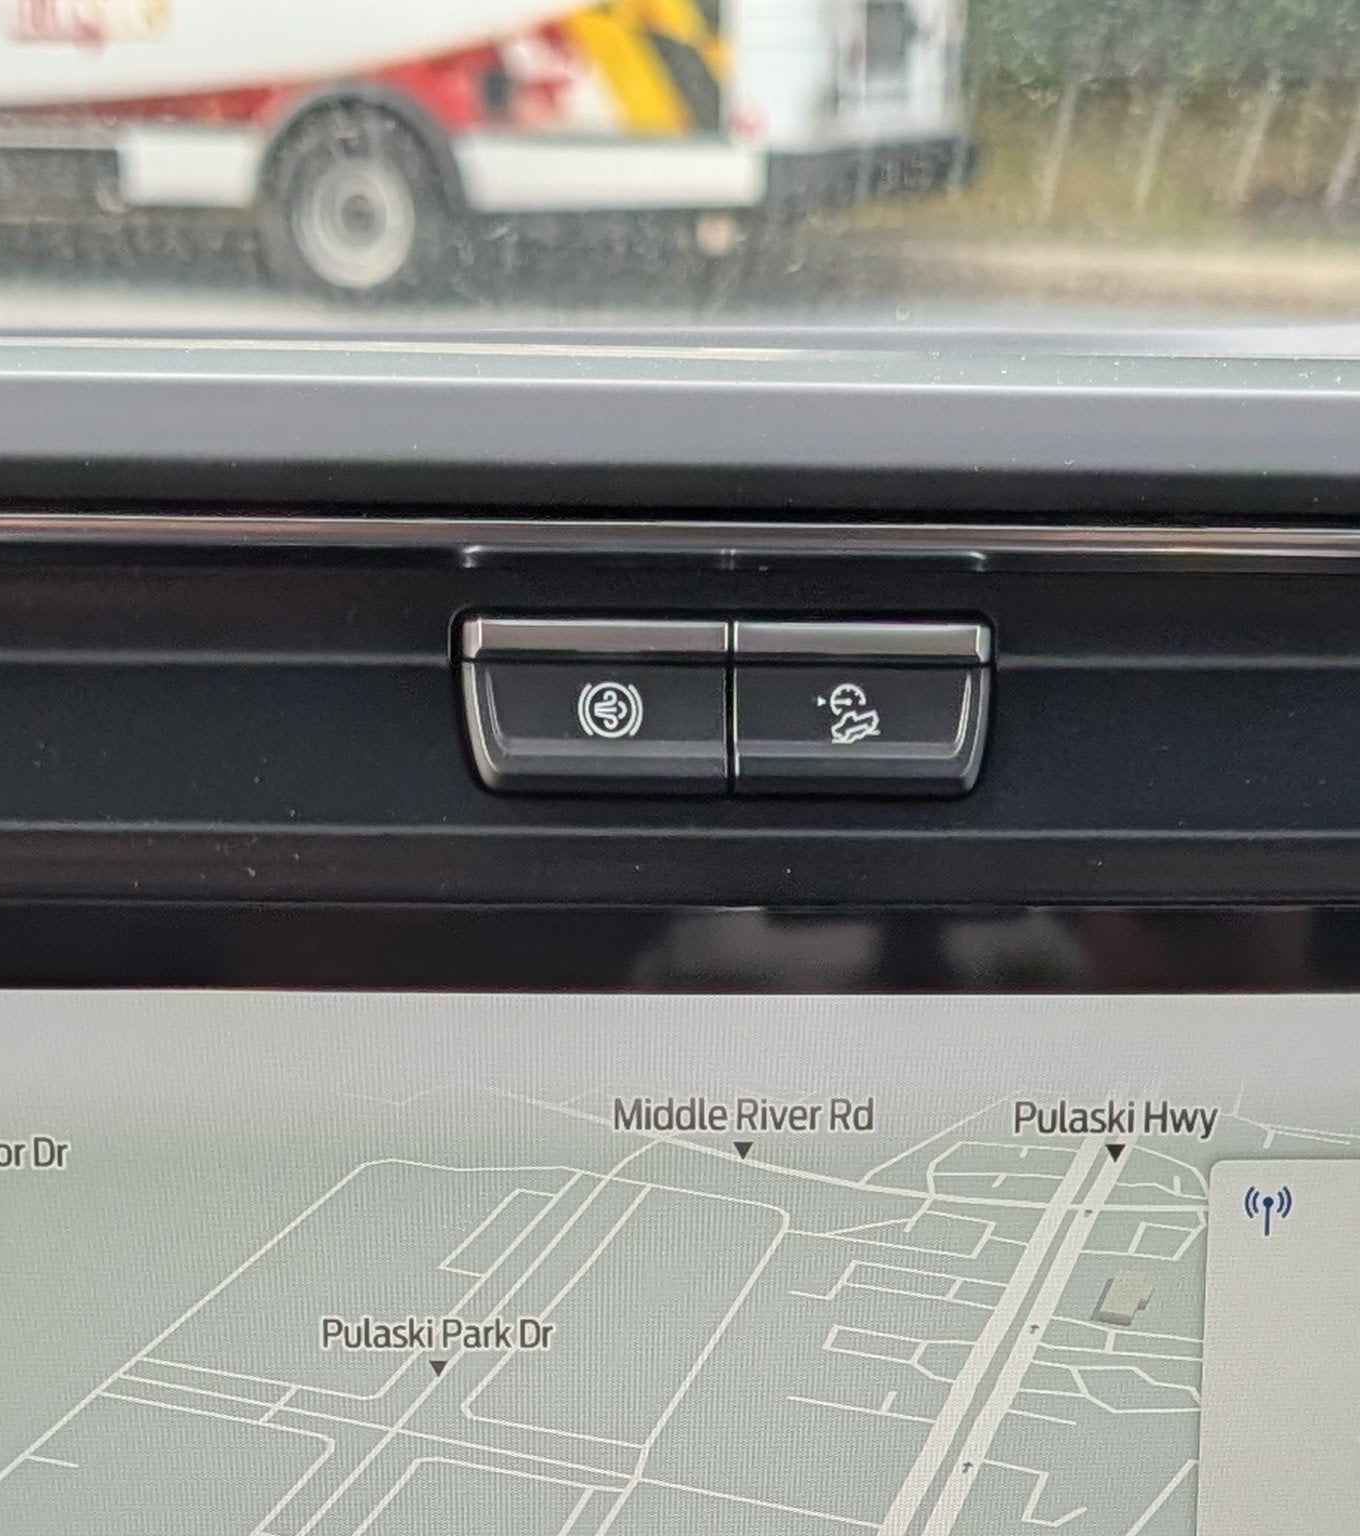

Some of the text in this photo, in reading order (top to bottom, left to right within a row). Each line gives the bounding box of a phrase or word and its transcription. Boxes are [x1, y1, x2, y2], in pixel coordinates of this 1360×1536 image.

[614, 1097, 874, 1131] Middle River Rd
[1015, 1100, 1218, 1140] Pulaski Hwy
[33, 1137, 68, 1167] Dr
[323, 1318, 553, 1348] Pulaski Park Dr
